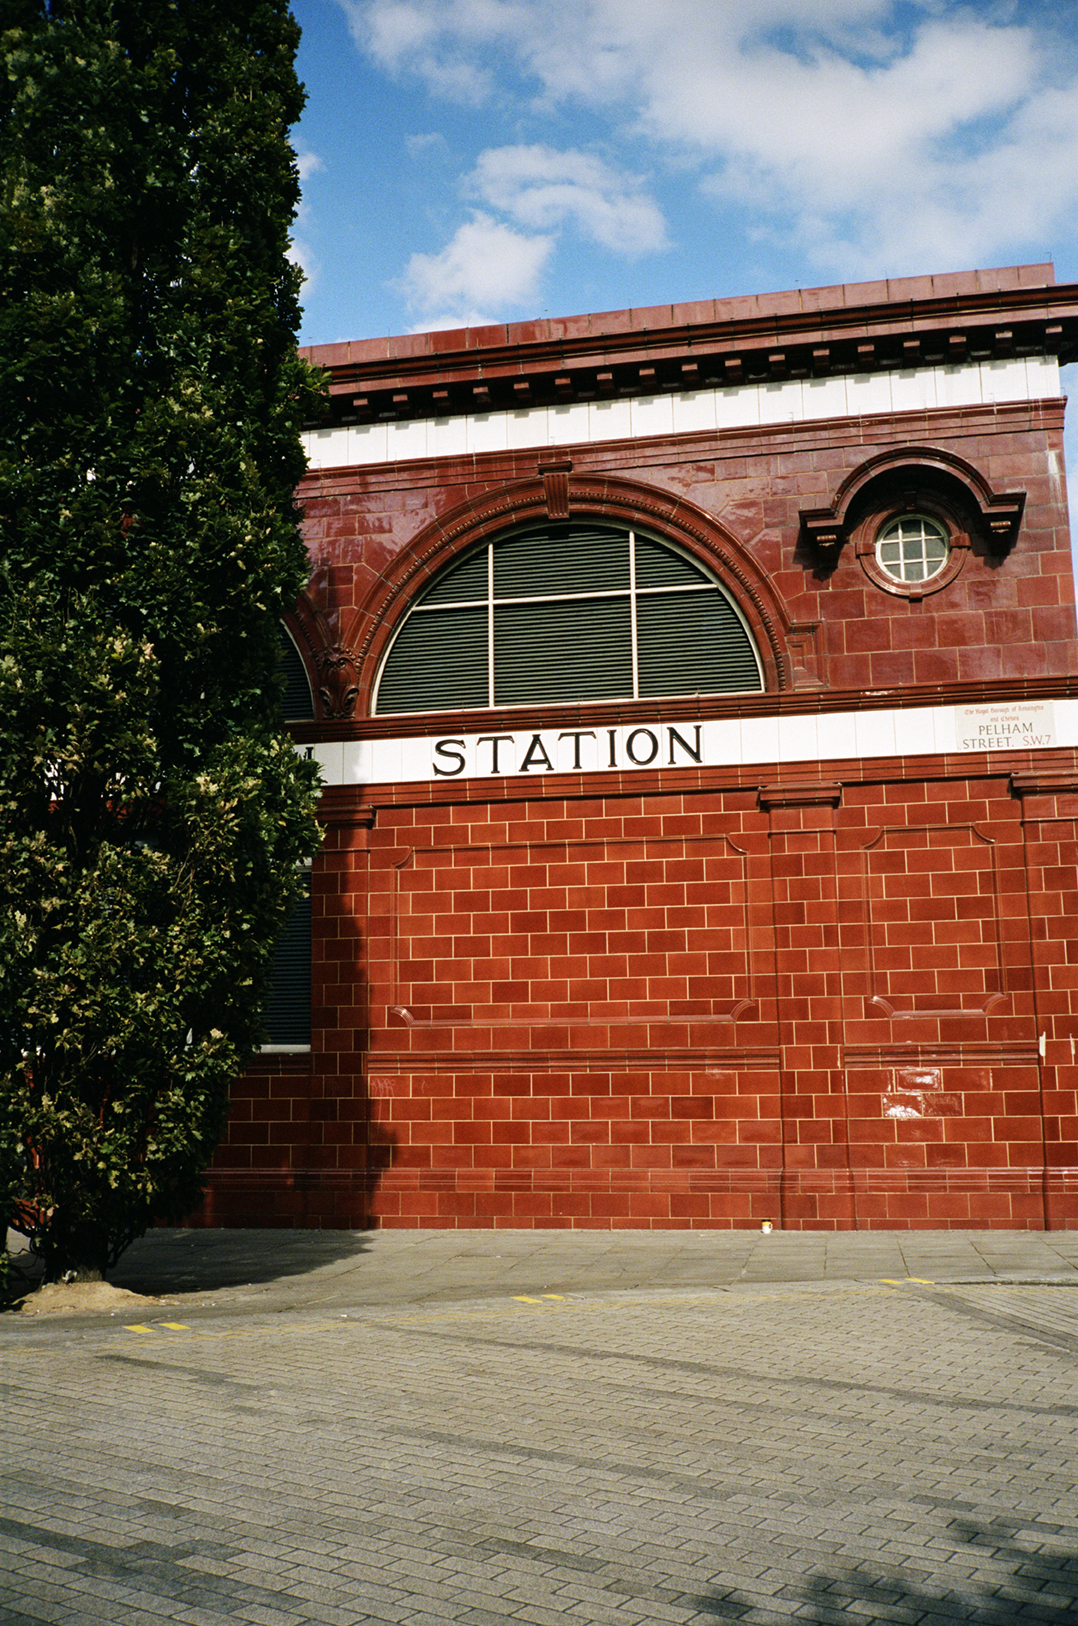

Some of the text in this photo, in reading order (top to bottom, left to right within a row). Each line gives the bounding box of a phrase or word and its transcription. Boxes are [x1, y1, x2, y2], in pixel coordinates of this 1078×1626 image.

[978, 722, 1033, 735] PELHAM
[1023, 735, 1051, 746] S.W.7
[433, 725, 702, 776] STATION
